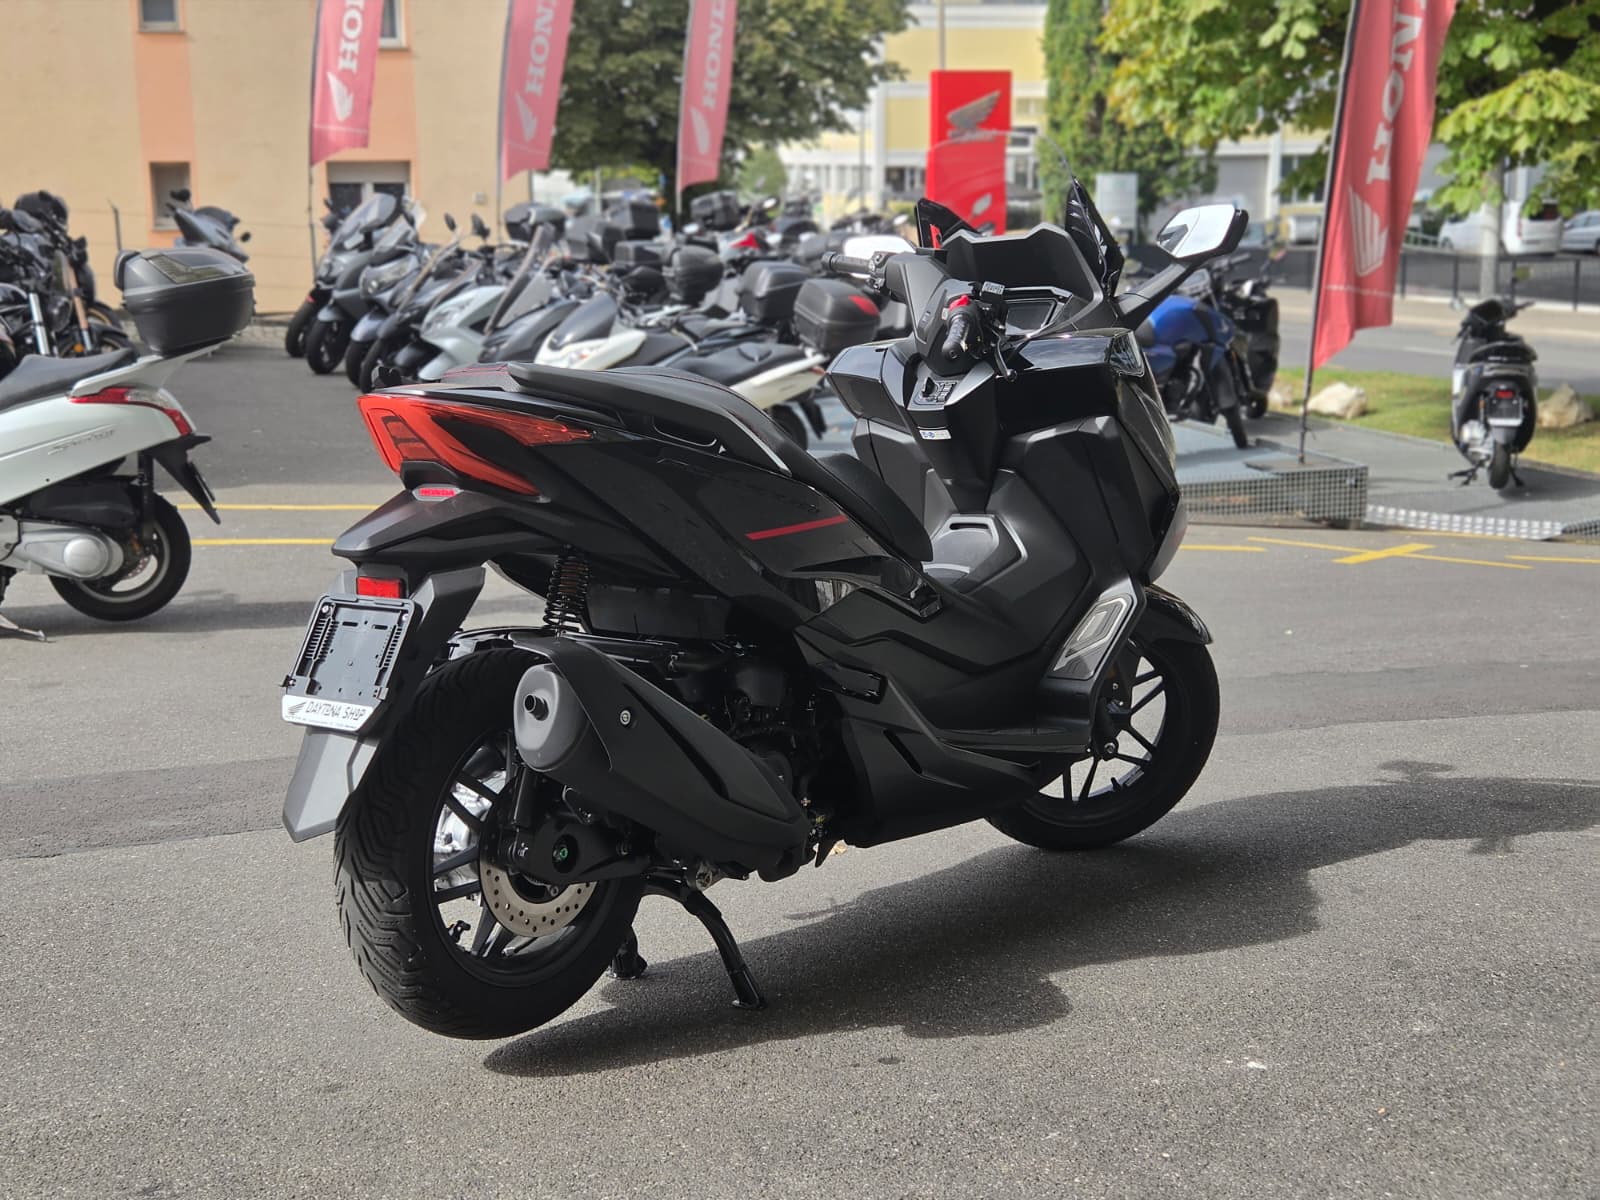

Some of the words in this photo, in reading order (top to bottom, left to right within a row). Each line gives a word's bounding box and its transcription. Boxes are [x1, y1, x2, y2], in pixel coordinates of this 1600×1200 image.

[525, 0, 557, 97] HON
[1366, 0, 1427, 185] HON
[305, 701, 342, 718] DAYTONA
[342, 706, 368, 721] SHOP
